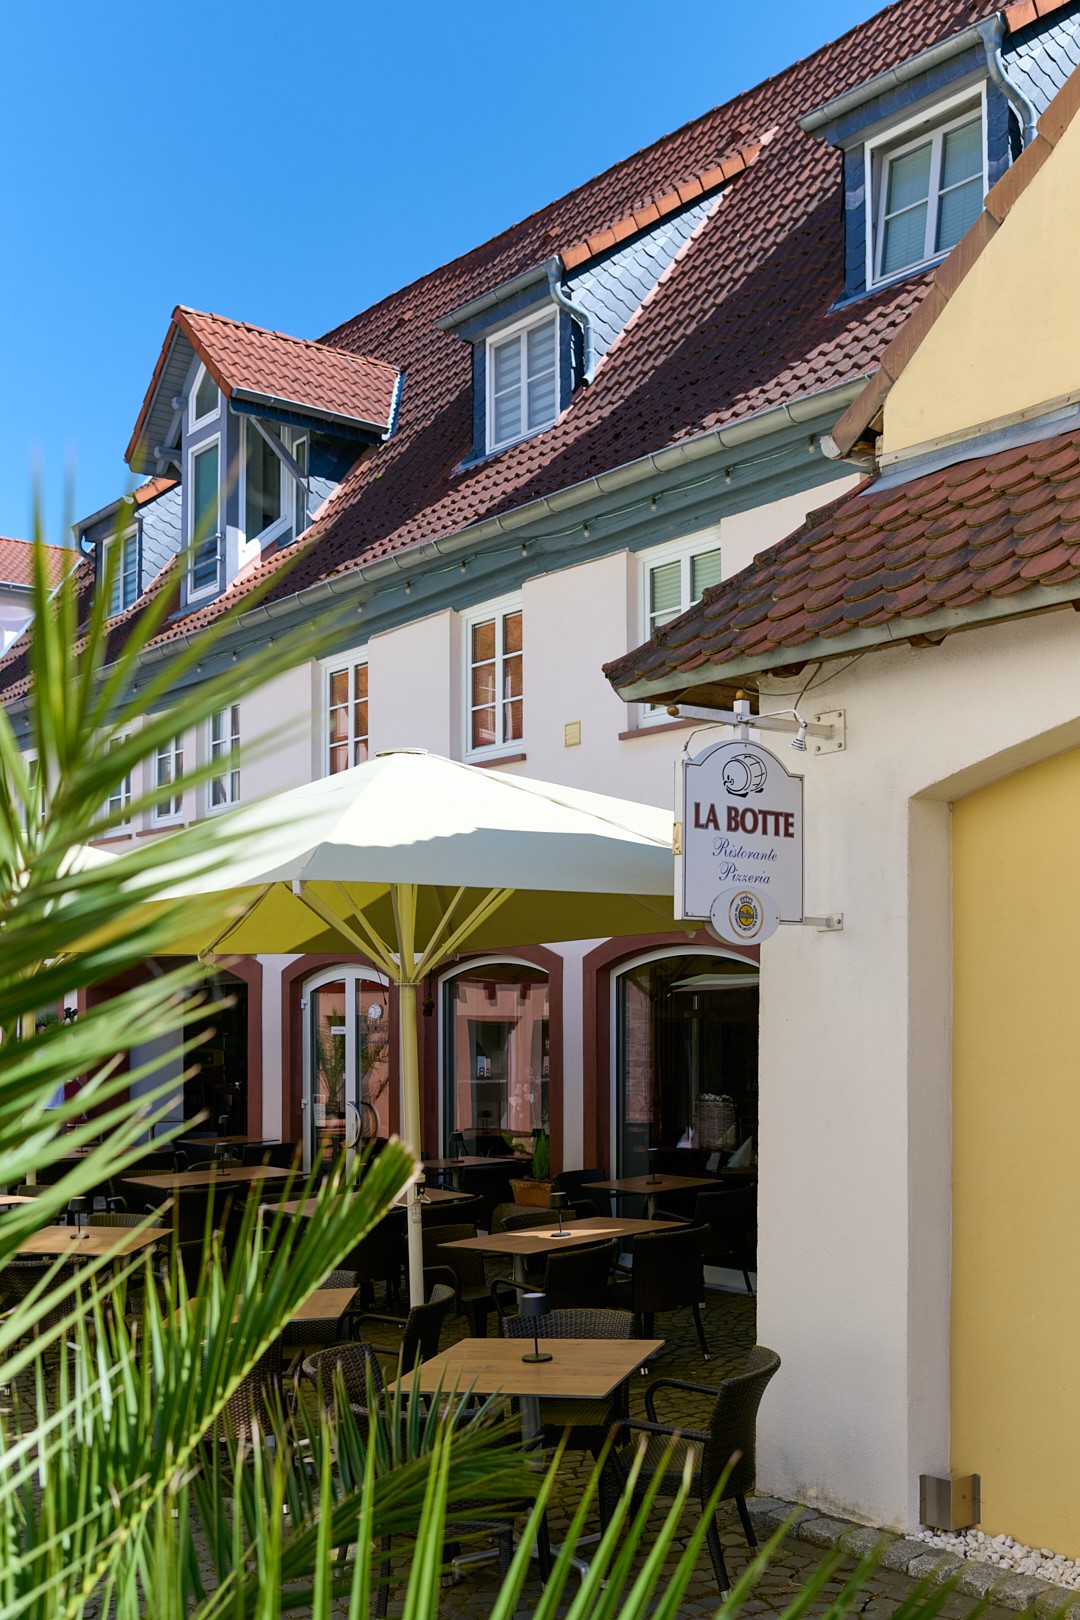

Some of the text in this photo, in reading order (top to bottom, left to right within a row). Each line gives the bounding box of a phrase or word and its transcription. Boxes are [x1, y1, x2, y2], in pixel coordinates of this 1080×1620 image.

[694, 801, 795, 838] LA BOTTE
[712, 836, 778, 861] Ristorante
[718, 861, 771, 884] Pizzeria
